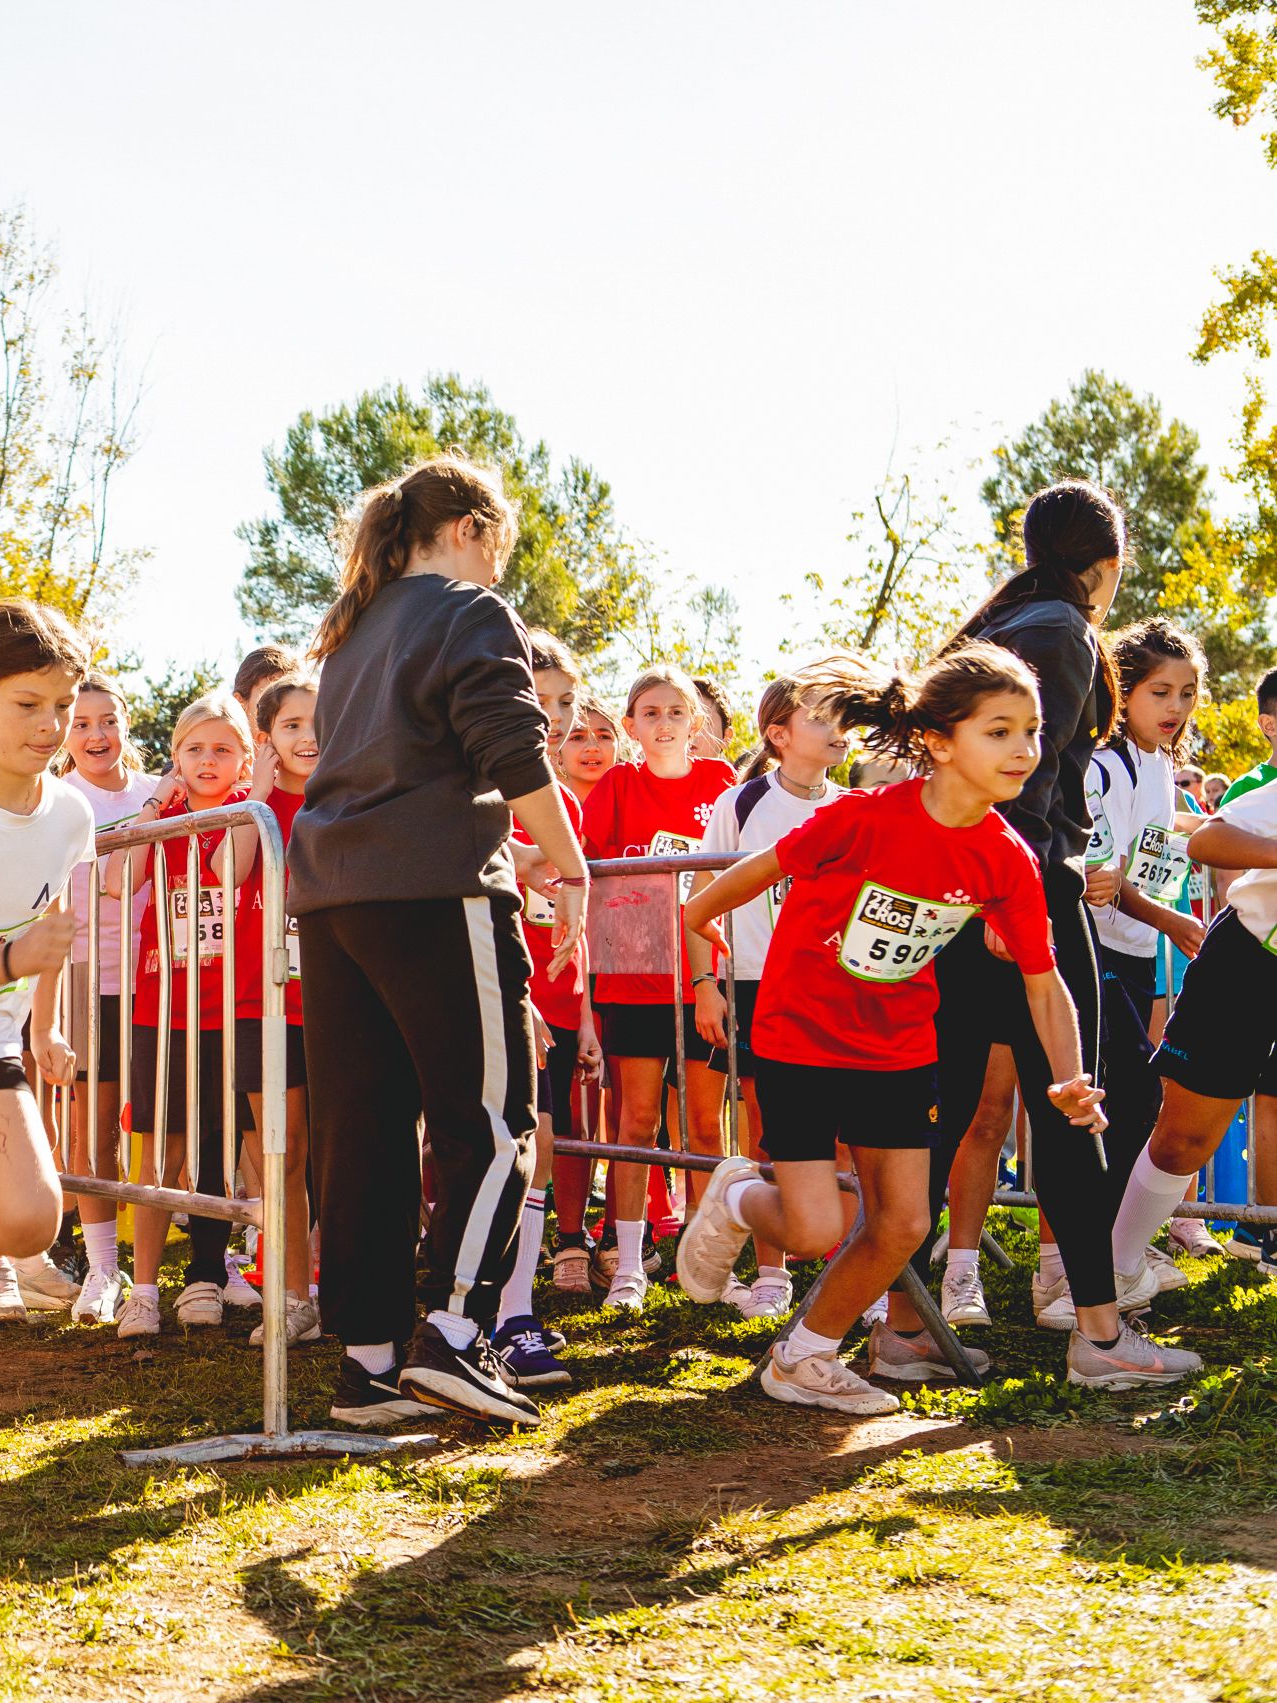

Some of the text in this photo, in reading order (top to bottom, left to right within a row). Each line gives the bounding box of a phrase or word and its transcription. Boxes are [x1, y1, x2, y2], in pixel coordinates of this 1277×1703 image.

[1142, 840, 1163, 853] CROS
[864, 904, 912, 928] CROS
[869, 938, 929, 964] 590
